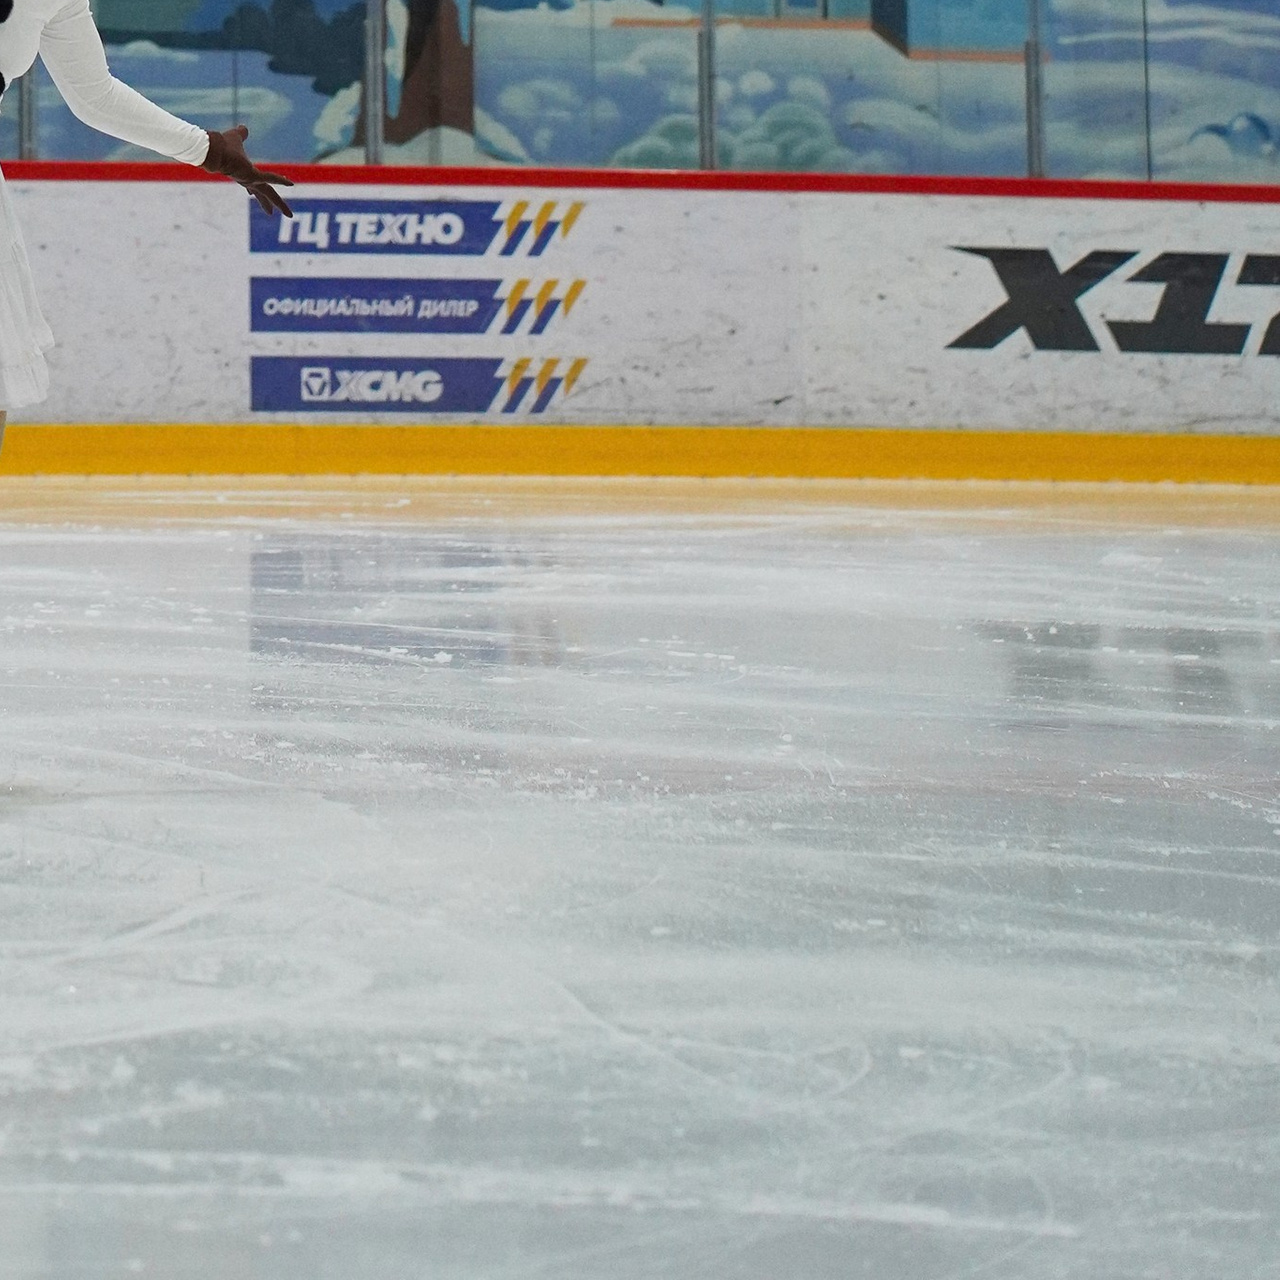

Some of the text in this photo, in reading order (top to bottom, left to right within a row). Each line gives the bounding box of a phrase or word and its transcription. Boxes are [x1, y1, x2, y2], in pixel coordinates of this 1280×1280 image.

[335, 212, 464, 245] ТЕХНО
[263, 295, 479, 319] ОФИЦИАЛЬНЫЙ ДИЛЕР
[331, 370, 444, 403] XCMG
